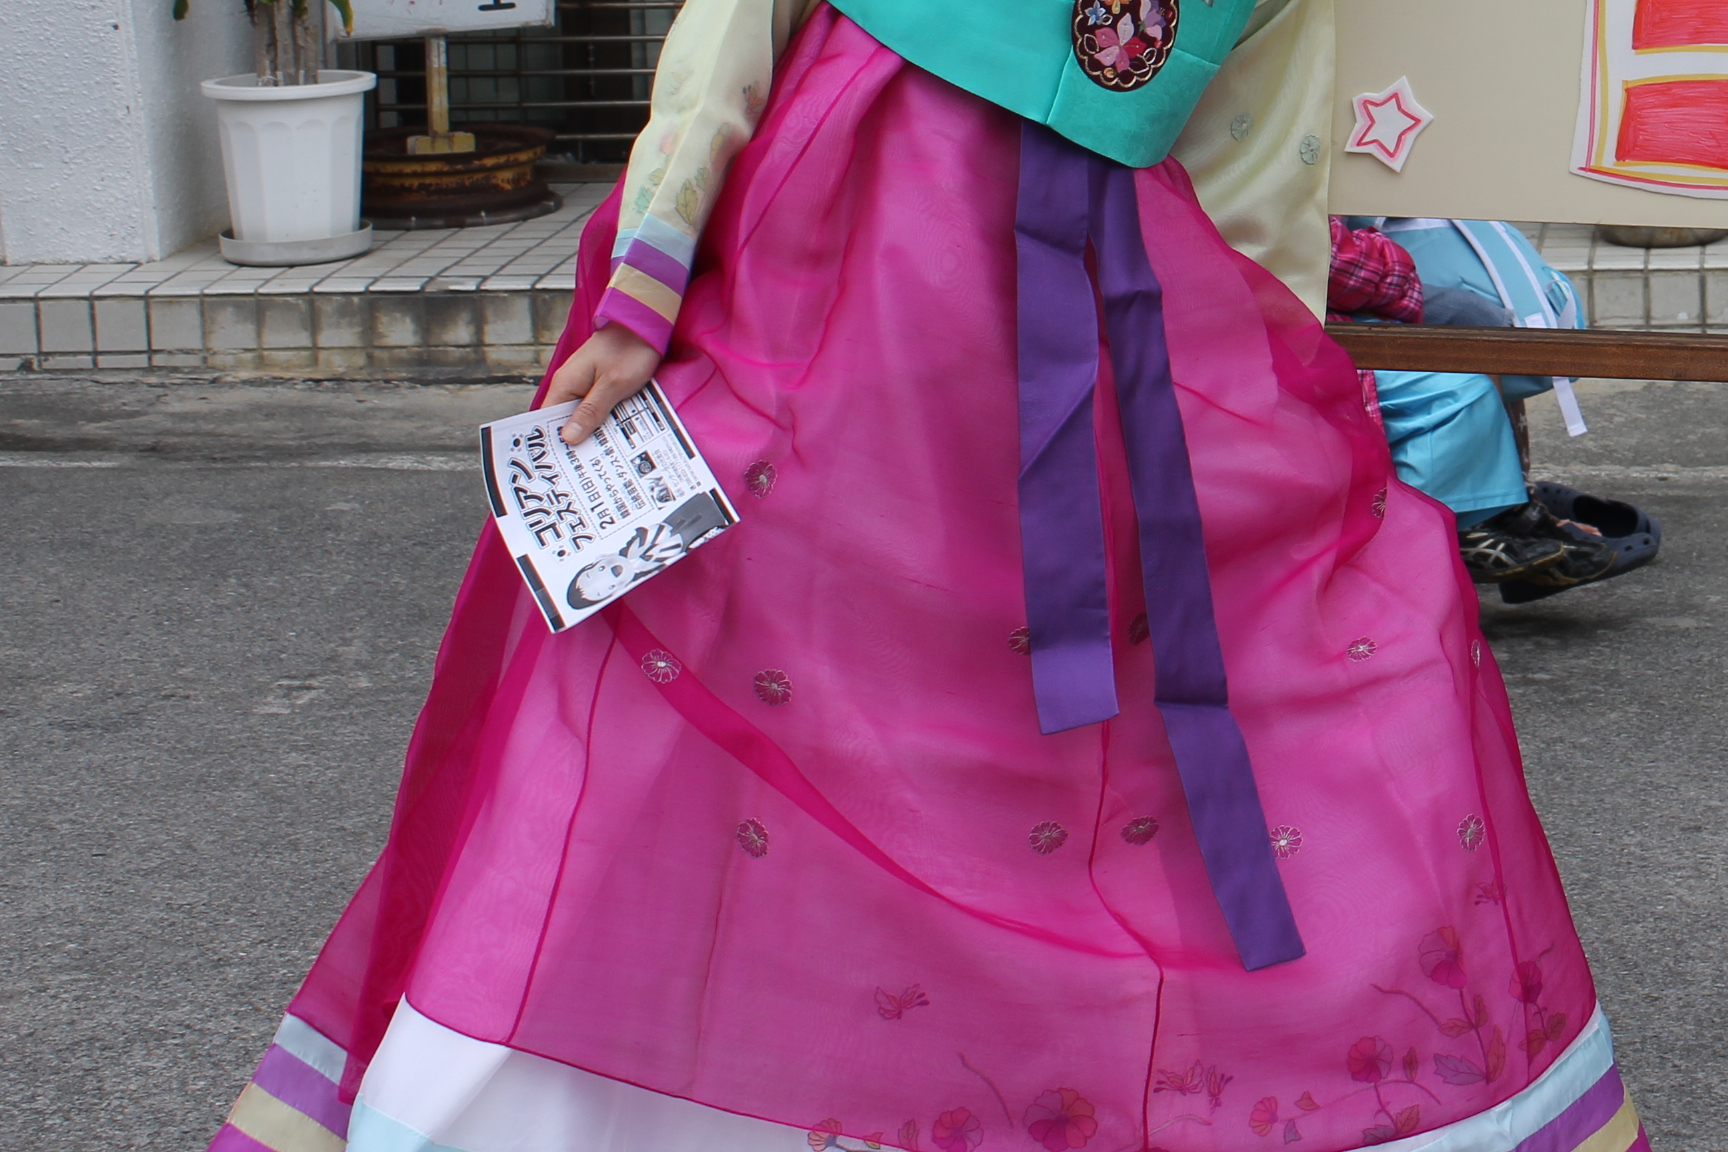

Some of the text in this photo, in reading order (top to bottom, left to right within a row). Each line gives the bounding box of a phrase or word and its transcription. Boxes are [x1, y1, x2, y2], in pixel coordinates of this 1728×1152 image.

[508, 457, 565, 549] コリアン
[526, 426, 595, 552] フェスティバル
